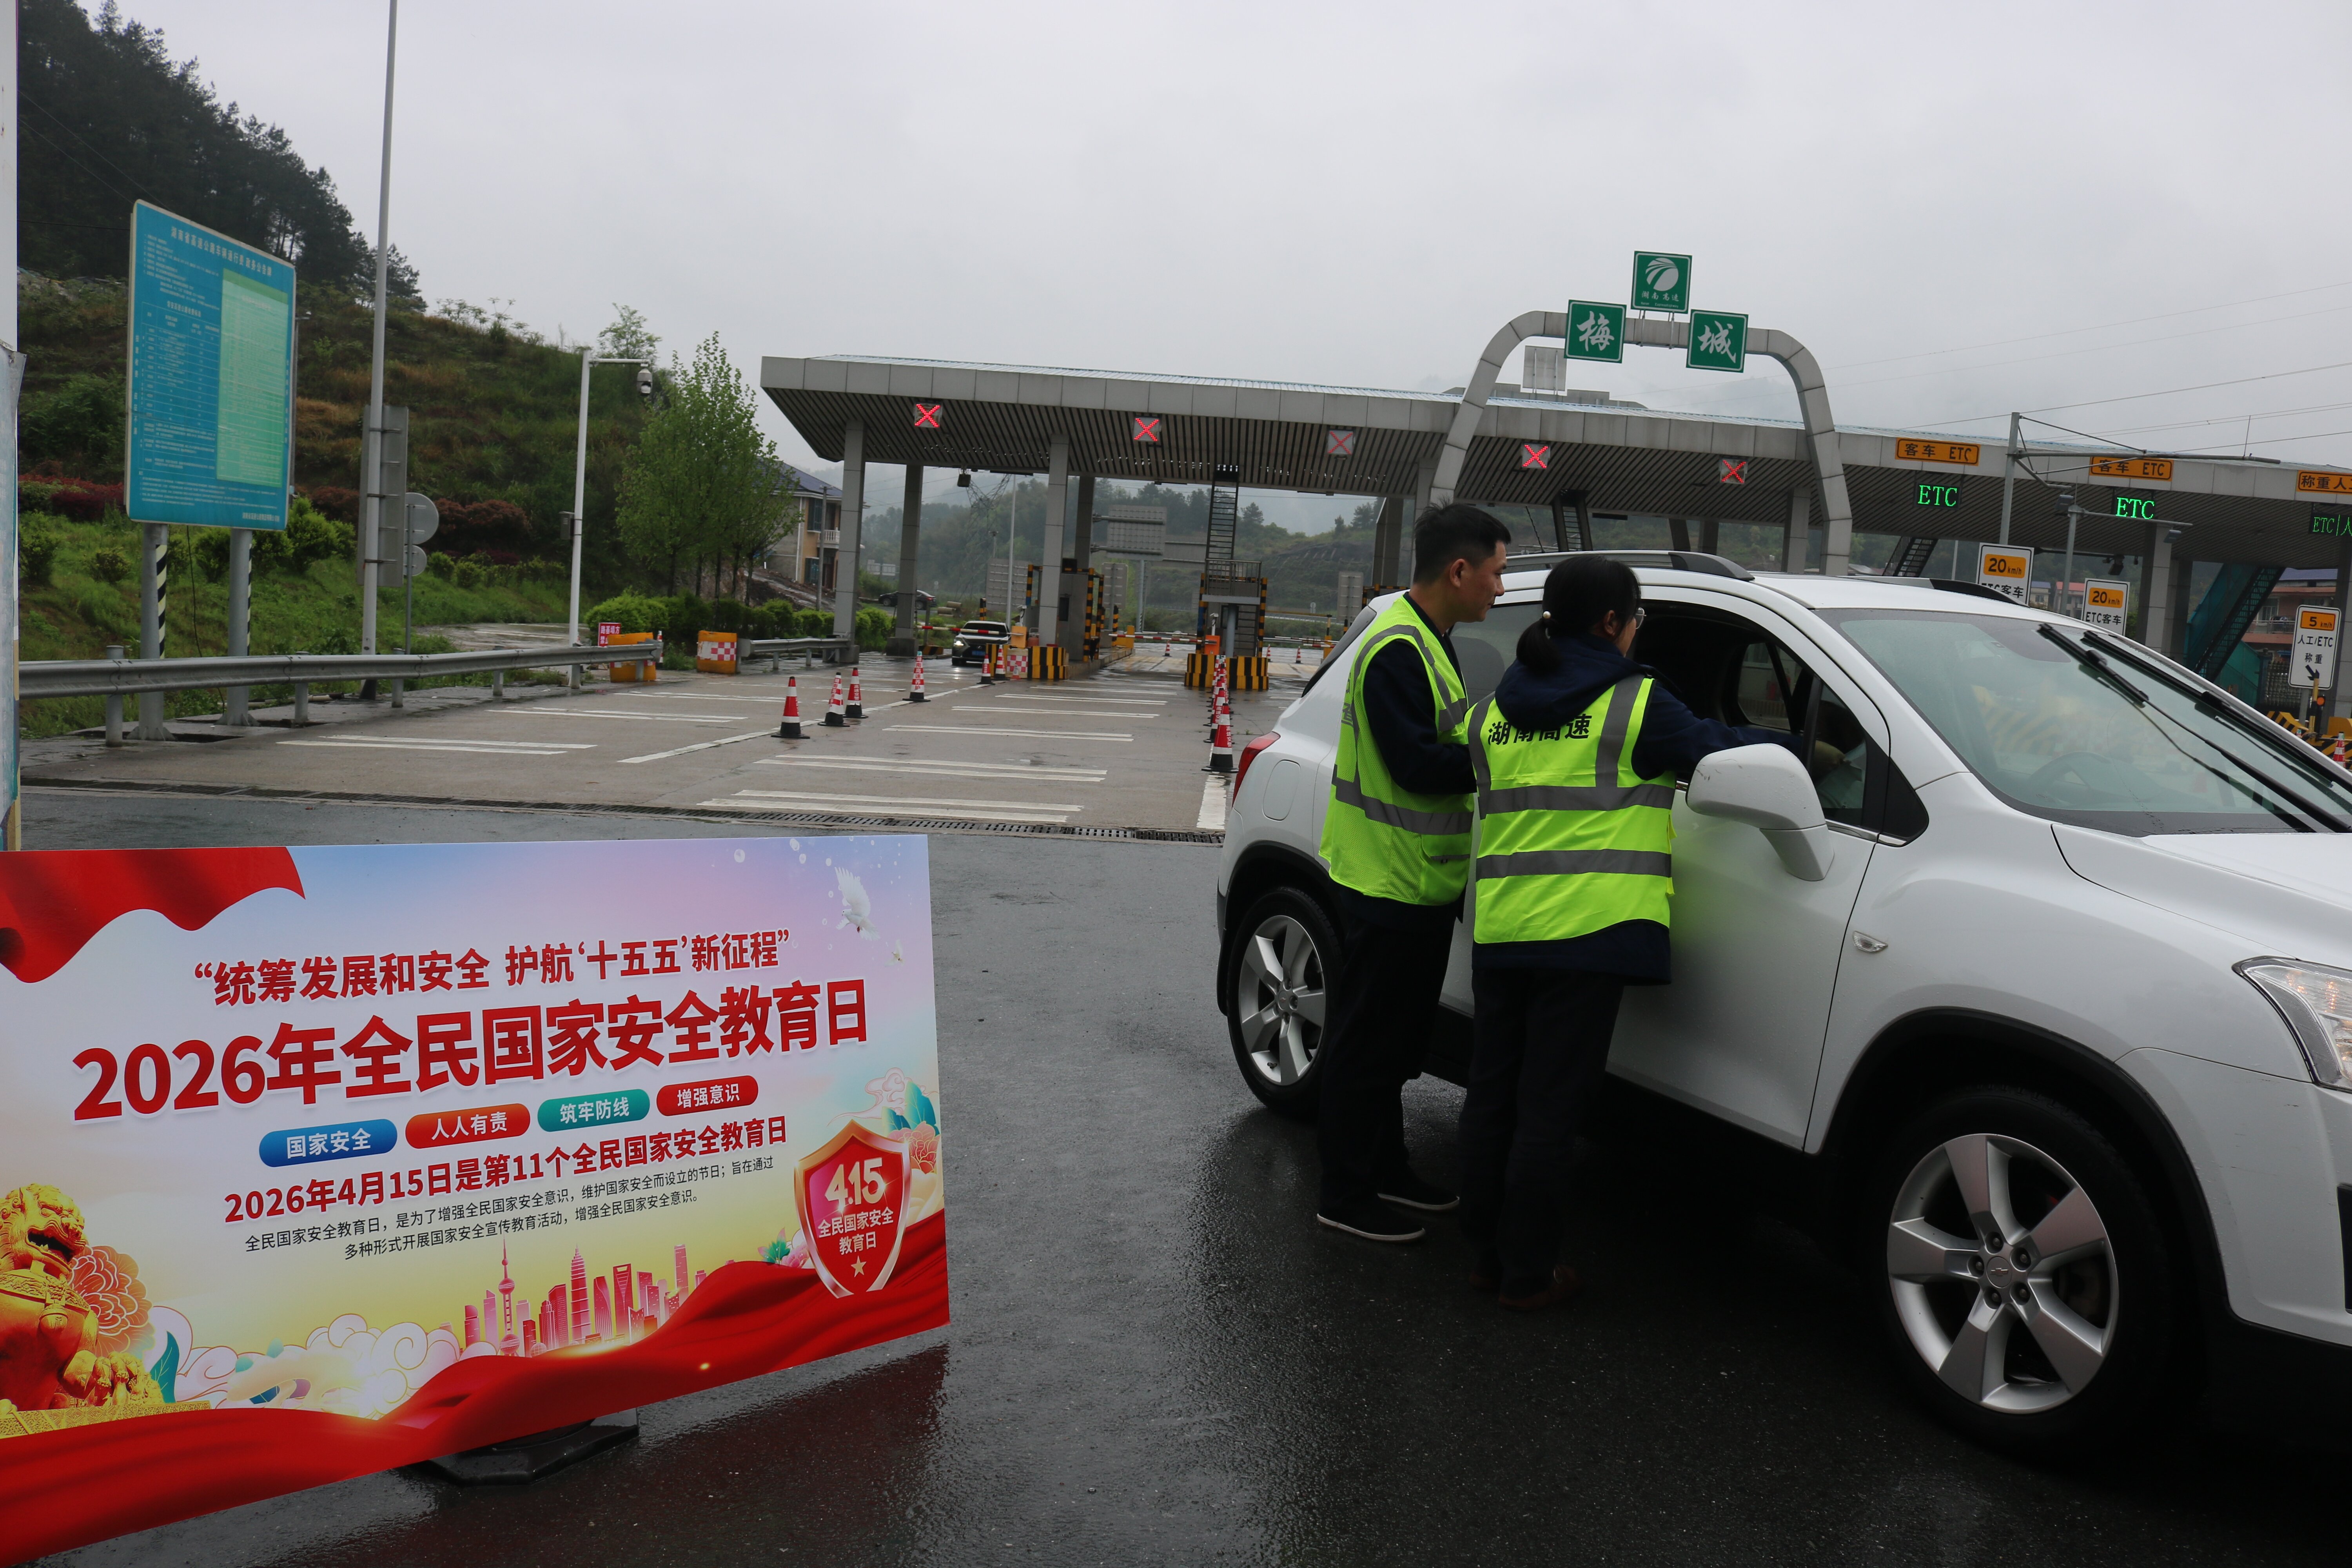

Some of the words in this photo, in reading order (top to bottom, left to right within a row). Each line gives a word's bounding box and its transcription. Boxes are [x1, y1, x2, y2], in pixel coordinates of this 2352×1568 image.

[1642, 291, 1679, 301] 湖南高速
[1577, 311, 1614, 351] 梅
[1698, 321, 1736, 363] 城
[1904, 443, 1936, 457] 客车
[1949, 446, 1972, 461] ETC
[2099, 459, 2129, 473] 客车
[2143, 462, 2165, 476] ETC
[2301, 475, 2352, 490] 称重人
[1917, 485, 1957, 506] ETC
[2116, 497, 2154, 519] ETC
[1988, 558, 2006, 573] 20
[2007, 566, 2022, 575] km/h
[2092, 591, 2107, 603] 20
[2086, 612, 2122, 625] ETC客车
[2309, 617, 2317, 627] 5
[2298, 635, 2334, 647] 人工/ETC
[2305, 653, 2323, 664] 称重
[72, 979, 867, 1120] 2026年全民国家安全教育日
[677, 1083, 740, 1108] 增强意识
[560, 1097, 629, 1124] 筑牢防线
[432, 1111, 507, 1140] 人人有责
[287, 1128, 371, 1159] 国家安全
[225, 1116, 786, 1223] 2026年4月15日是第11个全民国家安全教育日
[825, 1157, 885, 1206] 4.15
[345, 1190, 698, 1260] 多种形式开展国家安全宣传教育活动，增强全民国家安全意识。
[818, 1207, 894, 1238] 全民国家安全
[839, 1232, 876, 1255] 教育日
